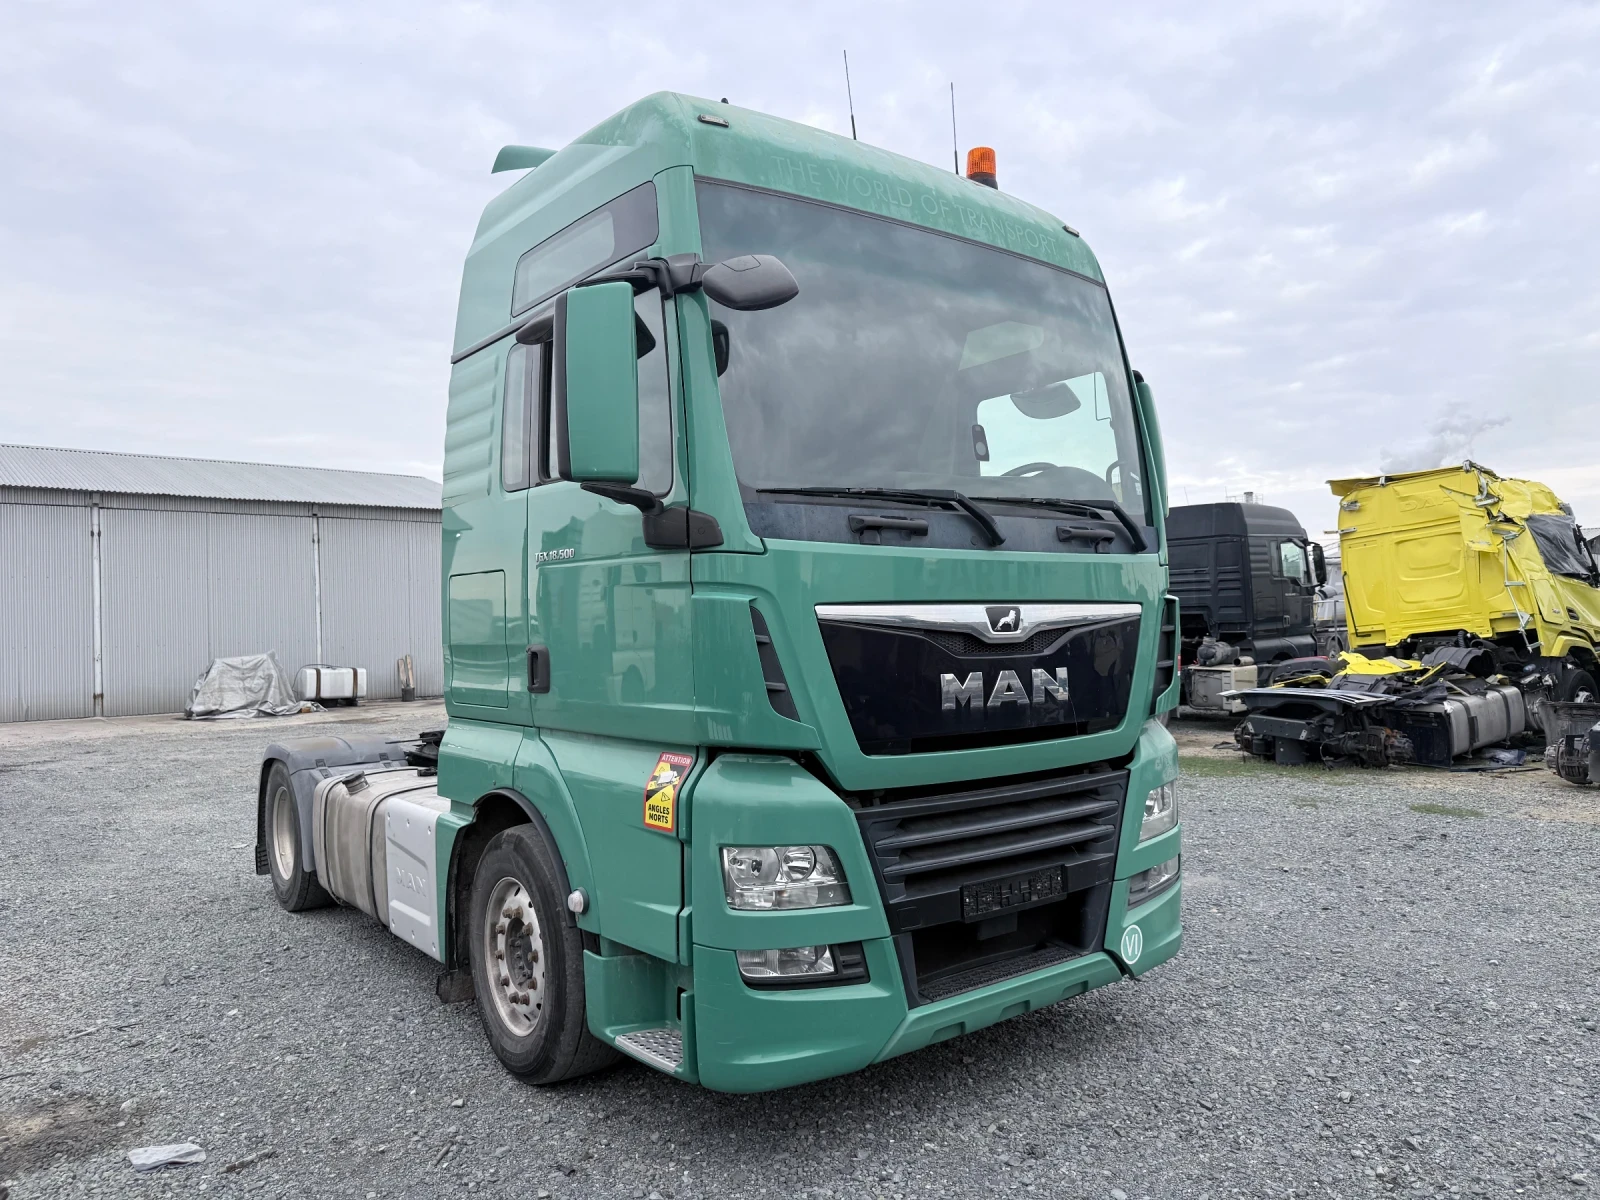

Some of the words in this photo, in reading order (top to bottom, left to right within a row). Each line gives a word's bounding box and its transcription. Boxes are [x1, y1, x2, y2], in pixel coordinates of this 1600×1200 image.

[771, 156, 821, 186] THE
[826, 164, 913, 207] WORLD
[920, 194, 949, 218] OF
[954, 203, 1056, 255] TRANSPORT
[535, 551, 549, 562] TGX
[940, 667, 1069, 710] MAN
[661, 753, 691, 765] ATTENTION
[648, 803, 670, 815] ANGLES
[648, 812, 669, 824] MORTS
